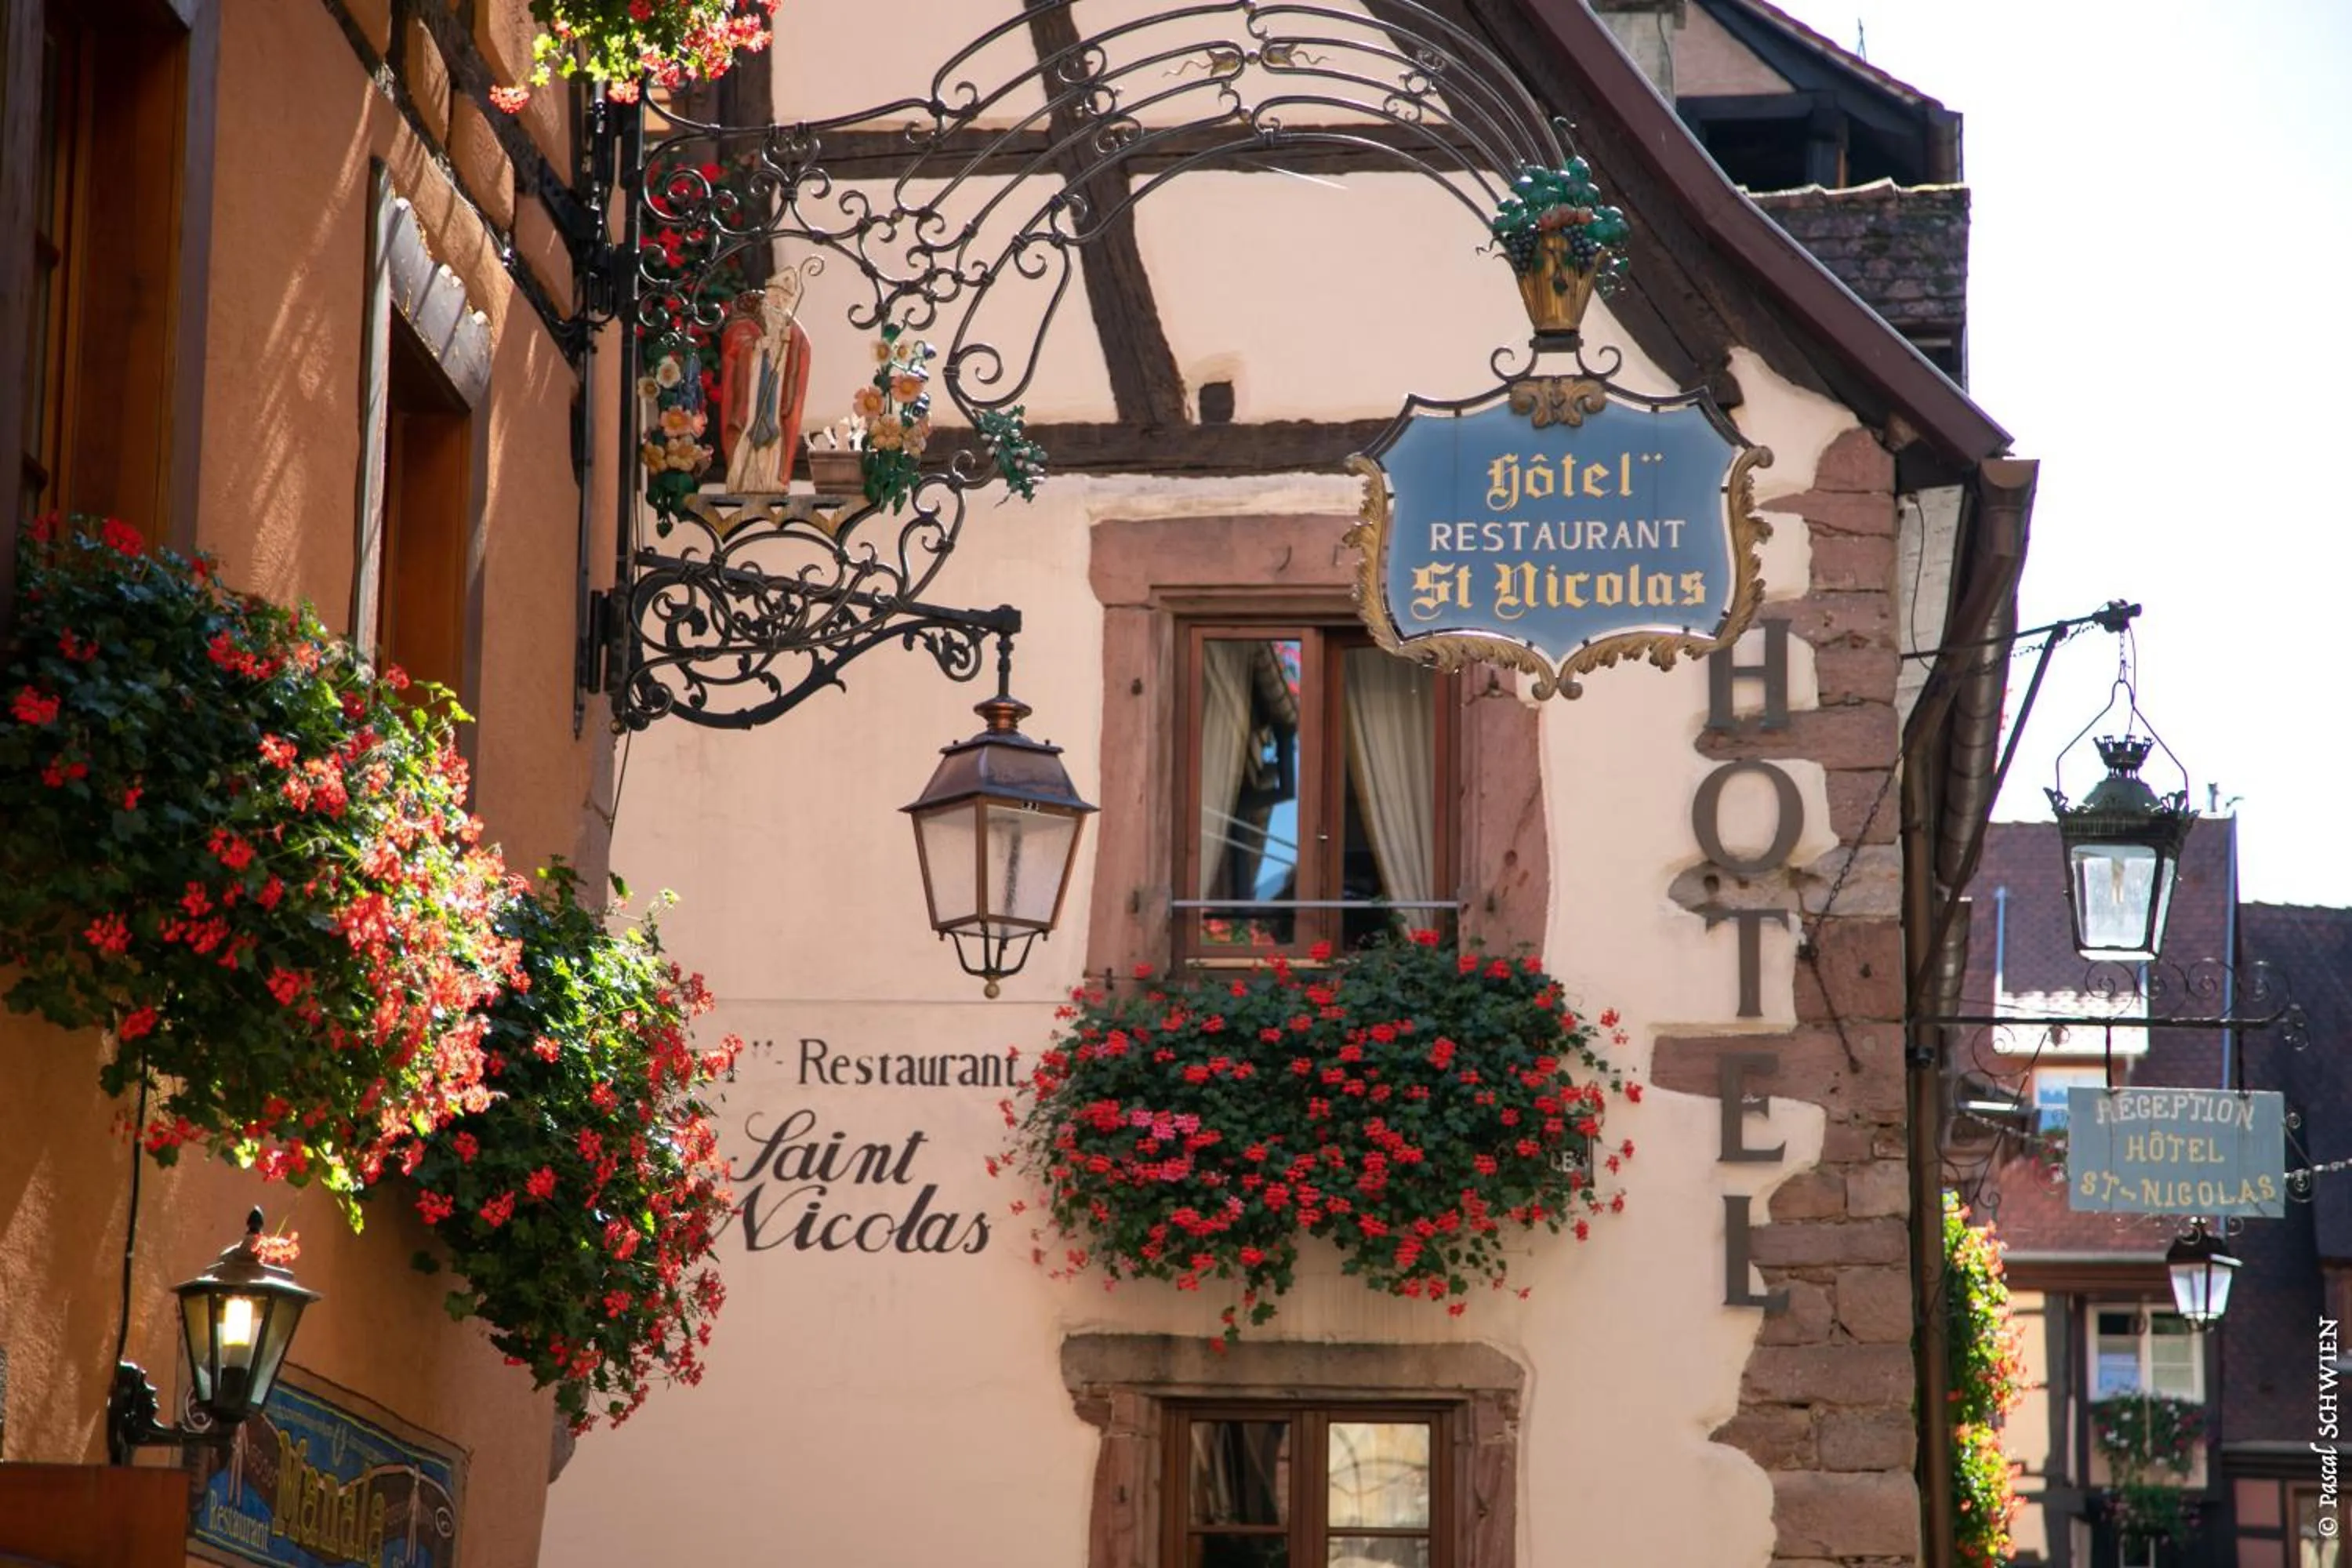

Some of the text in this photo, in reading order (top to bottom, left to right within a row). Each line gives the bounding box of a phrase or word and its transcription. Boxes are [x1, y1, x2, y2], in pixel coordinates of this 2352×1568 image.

[1486, 451, 1634, 511] Hôtel
[1428, 520, 1686, 552] RESTAURANT
[1411, 559, 1708, 620] St Nicolas
[1692, 618, 1804, 1307] HOTEL
[798, 1038, 1018, 1087] Restaurant
[730, 1109, 929, 1184] Saint
[2125, 1130, 2226, 1163] HÔTEL
[713, 1182, 992, 1254] Nicolas
[208, 1489, 270, 1554] Restaurant
